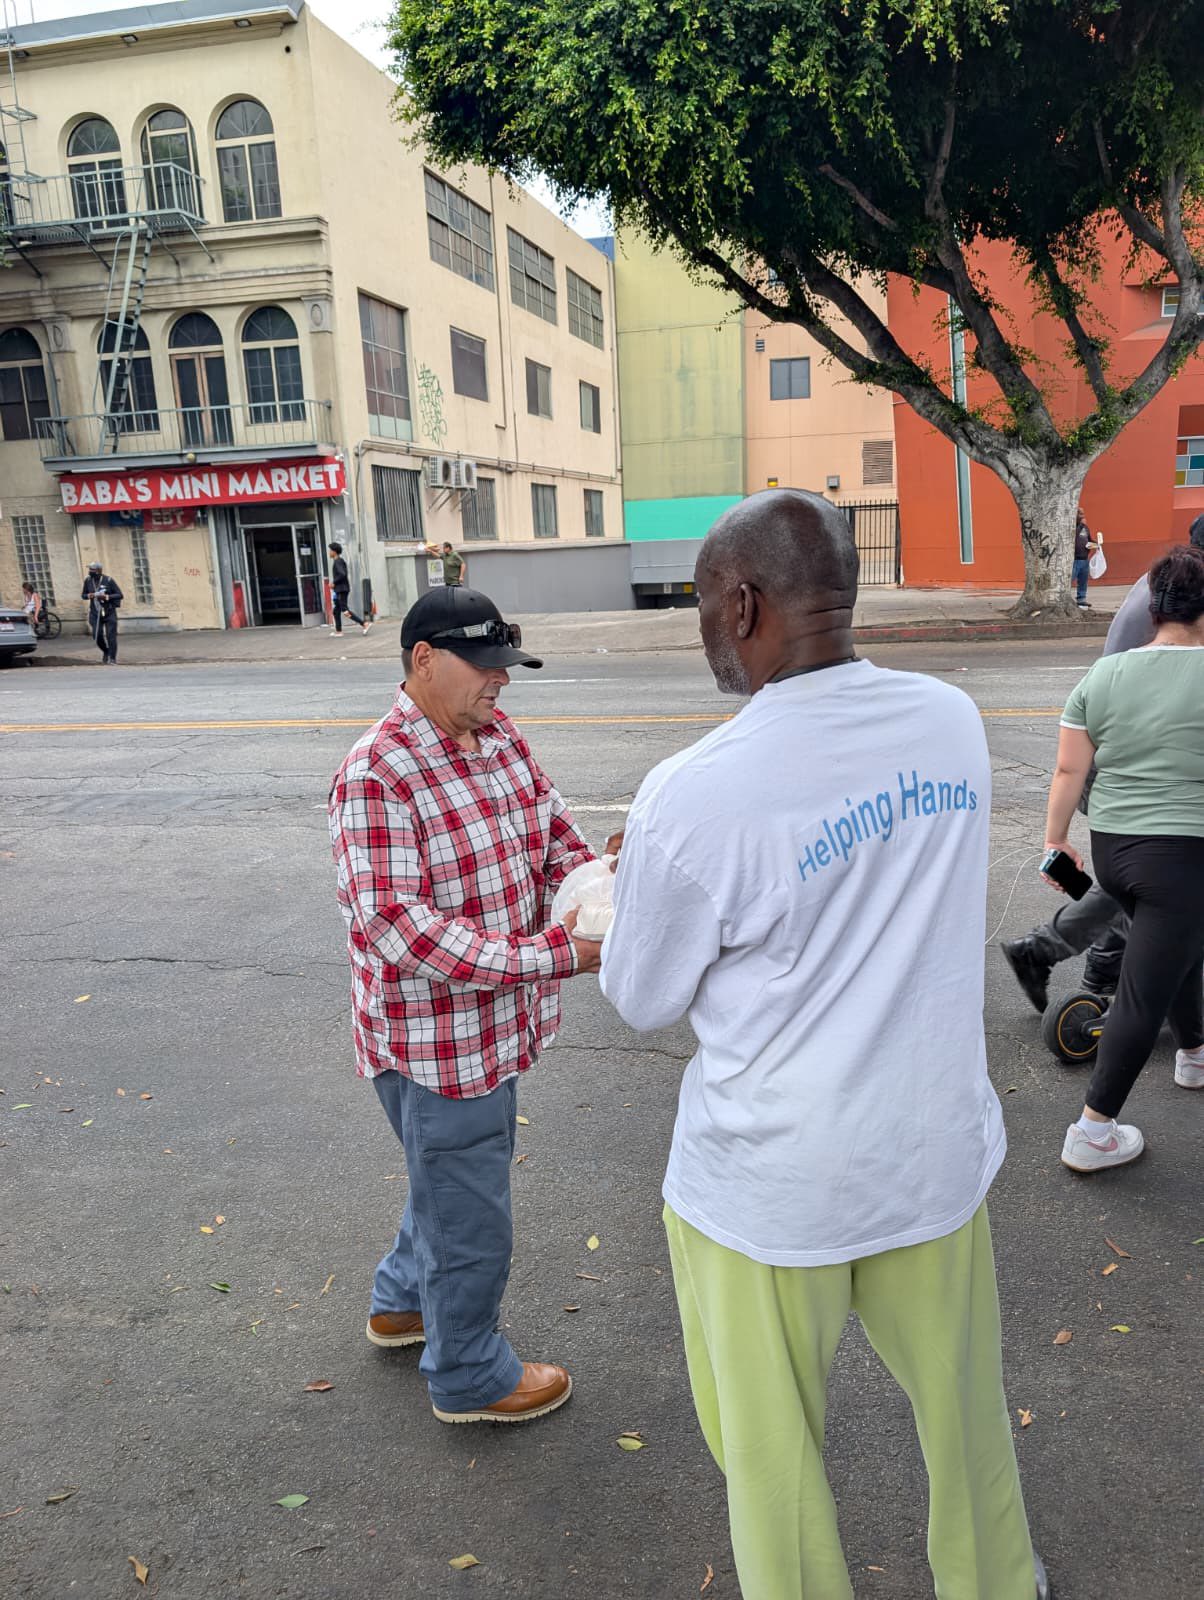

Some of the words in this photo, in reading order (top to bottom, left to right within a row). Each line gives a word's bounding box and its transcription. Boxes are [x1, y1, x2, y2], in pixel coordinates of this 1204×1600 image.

[60, 478, 153, 506] BABA'S
[160, 473, 220, 501] MINI
[229, 464, 340, 496] MARKET
[152, 510, 185, 526] EBT
[798, 791, 893, 882] Helping
[898, 770, 977, 820] Hands
